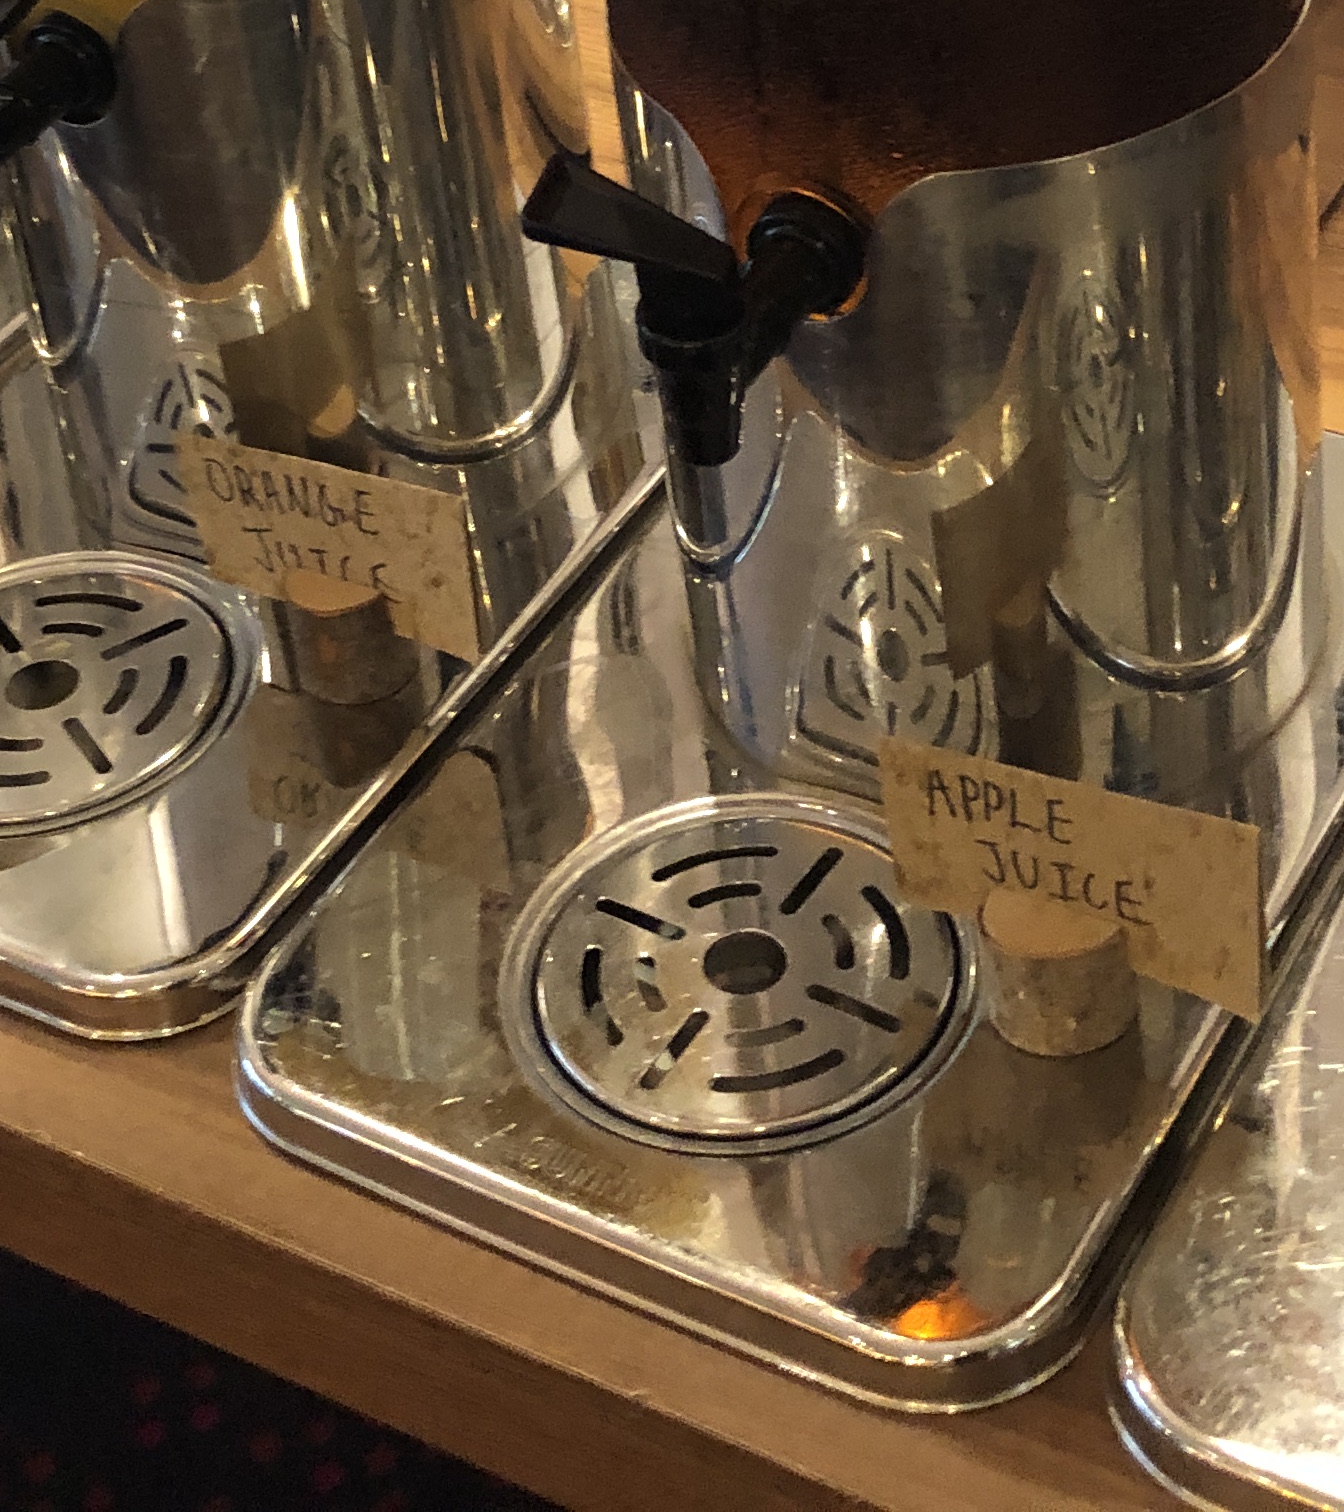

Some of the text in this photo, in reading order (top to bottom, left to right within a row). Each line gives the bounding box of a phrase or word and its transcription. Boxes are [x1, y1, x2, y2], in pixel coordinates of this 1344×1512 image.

[203, 457, 379, 535] ORANGE
[923, 768, 1074, 845] APPLE
[974, 839, 1154, 926] JUICE
